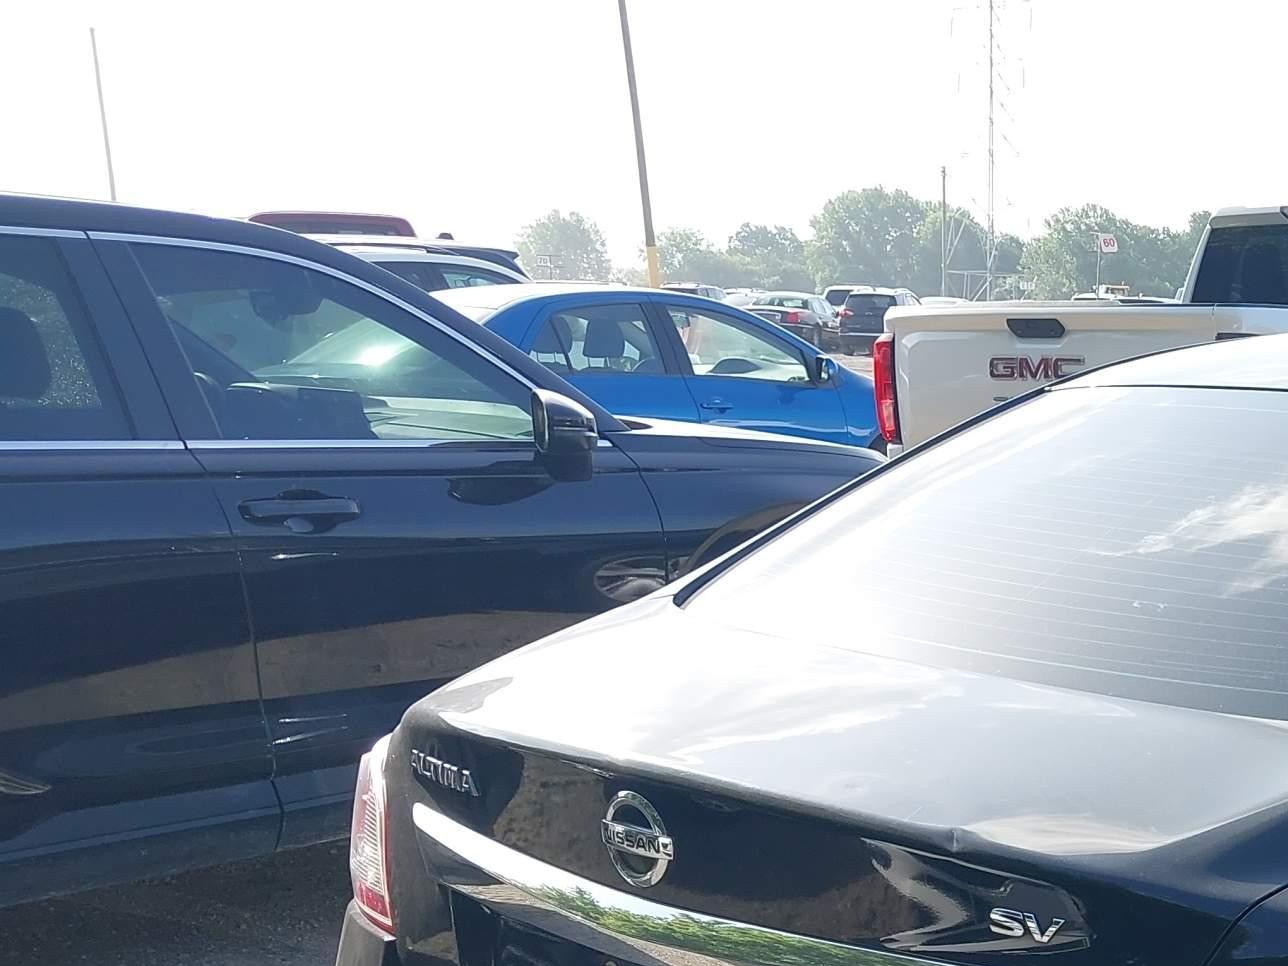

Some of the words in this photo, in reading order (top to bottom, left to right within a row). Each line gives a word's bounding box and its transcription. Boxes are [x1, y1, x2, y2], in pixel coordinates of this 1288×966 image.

[990, 357, 1085, 380] GMC
[408, 749, 479, 796] ALTIMA
[606, 826, 661, 855] NISSAN
[989, 907, 1066, 944] SV
